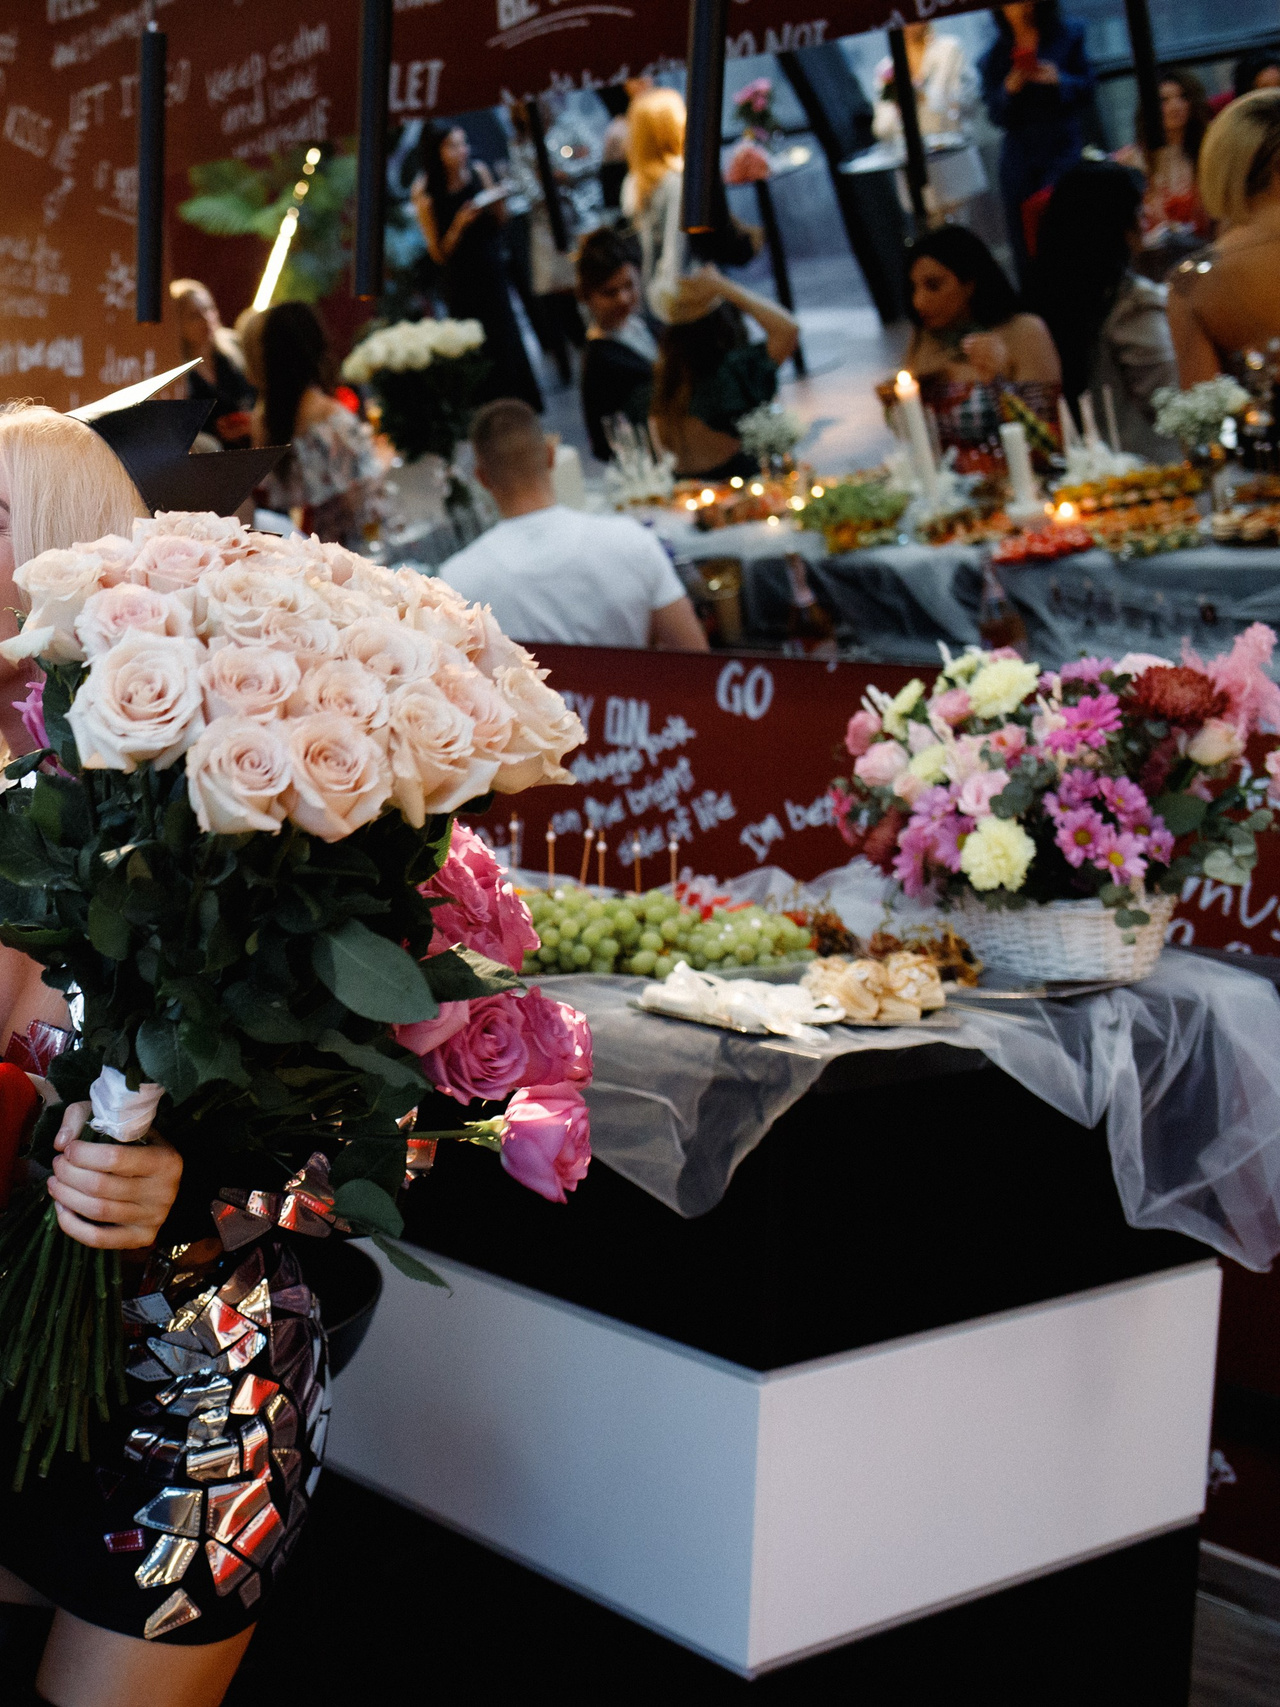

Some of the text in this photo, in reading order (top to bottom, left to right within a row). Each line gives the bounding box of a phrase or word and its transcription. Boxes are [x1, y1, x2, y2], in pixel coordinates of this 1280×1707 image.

[388, 59, 445, 113] LET
[716, 659, 774, 721] GO
[603, 695, 651, 752] ON
